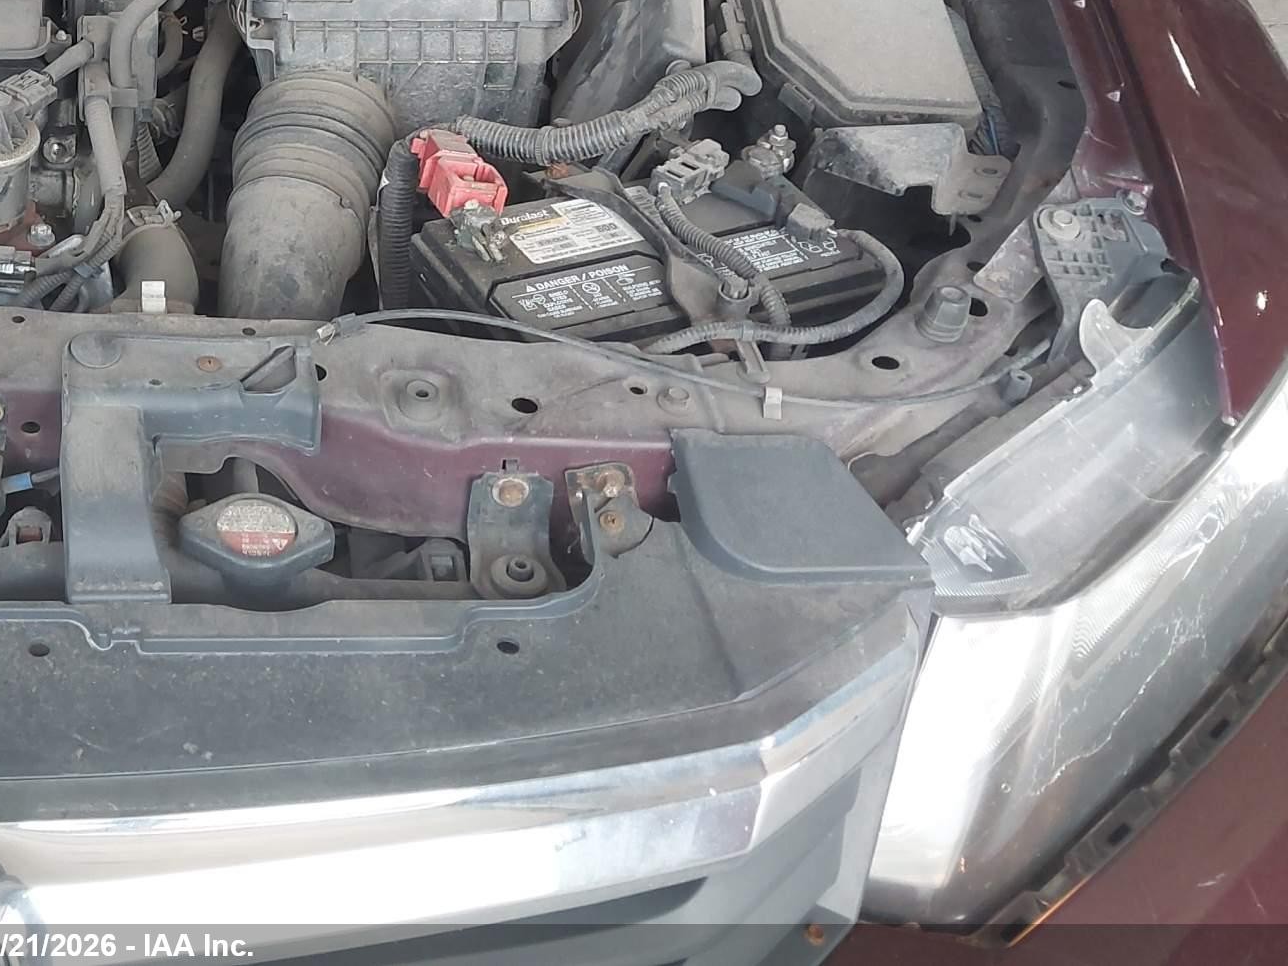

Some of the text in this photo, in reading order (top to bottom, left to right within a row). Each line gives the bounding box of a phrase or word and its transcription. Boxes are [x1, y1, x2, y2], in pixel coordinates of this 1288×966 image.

[500, 209, 550, 226] Duralast
[535, 275, 582, 291] DANGER
[588, 264, 630, 278] POISON
